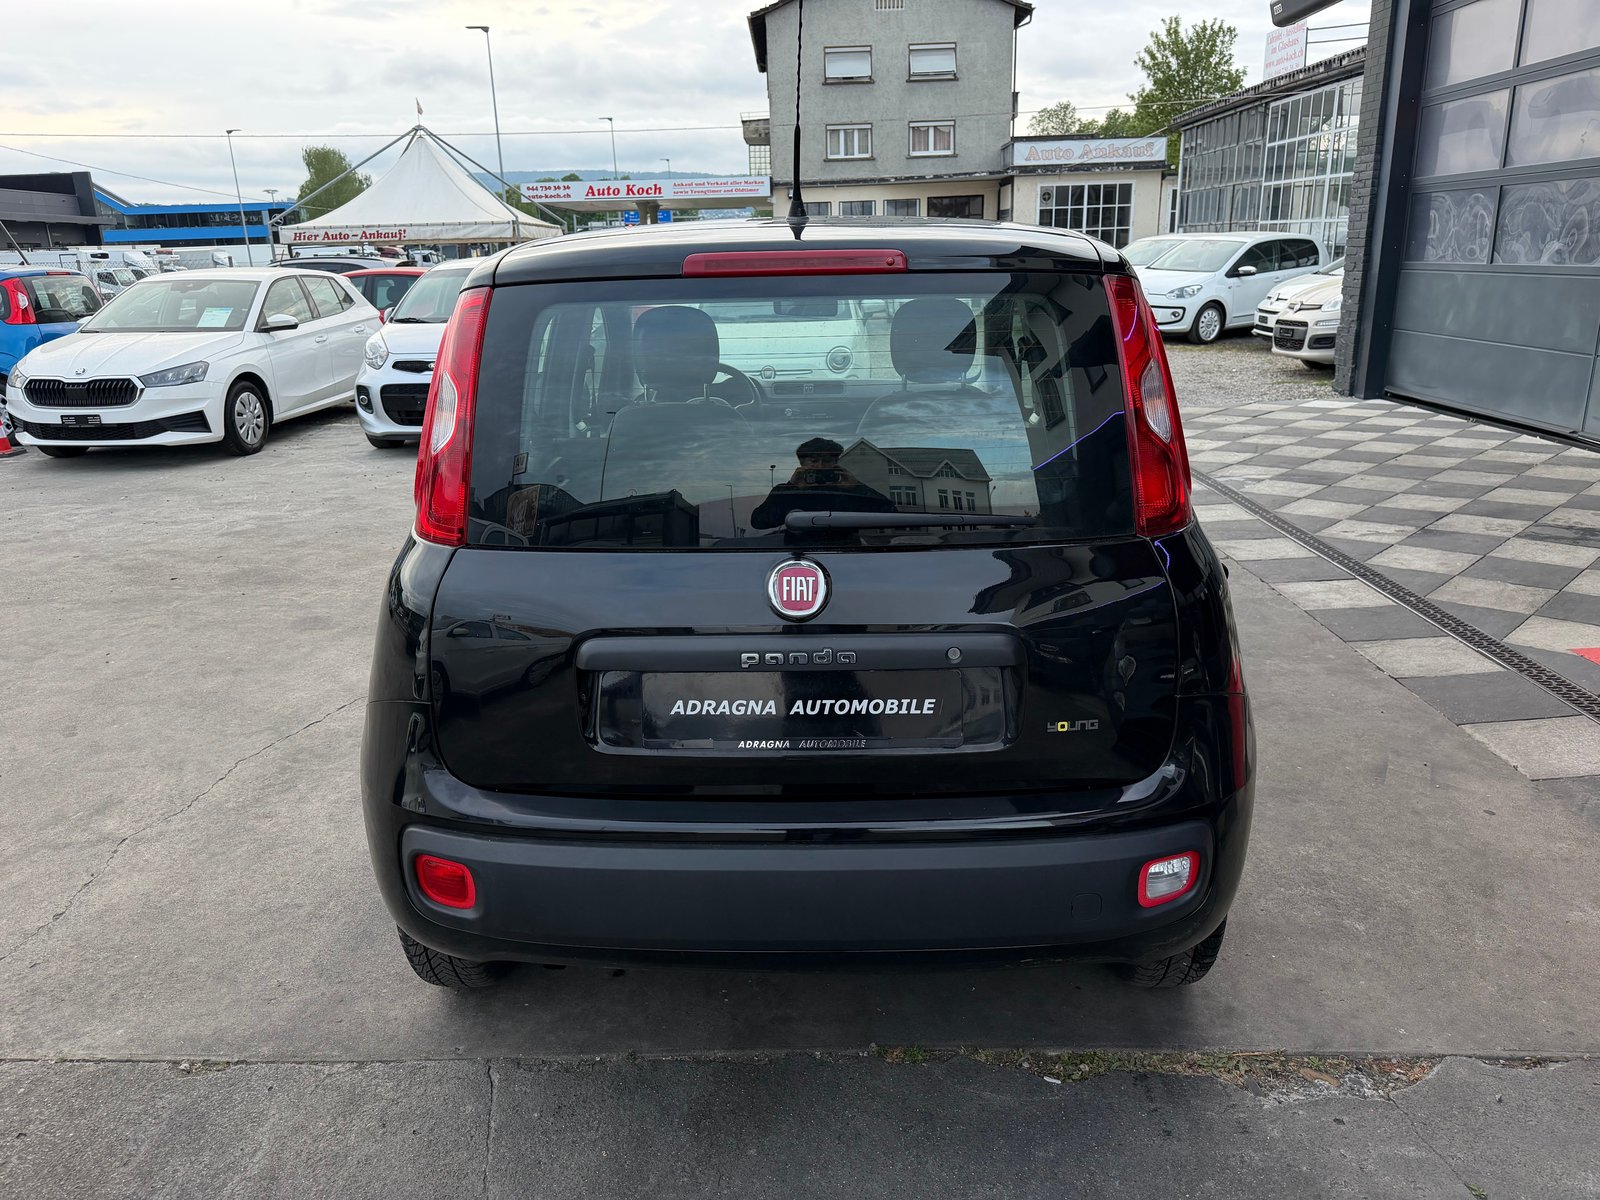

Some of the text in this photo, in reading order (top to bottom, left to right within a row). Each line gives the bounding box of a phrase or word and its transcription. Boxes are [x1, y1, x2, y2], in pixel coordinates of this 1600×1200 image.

[1024, 141, 1155, 161] Auto Ankauf
[585, 183, 663, 196] Auto Koch
[293, 231, 319, 241] Hier
[782, 576, 815, 601] FIAT
[740, 648, 857, 668] panda
[669, 698, 937, 715] ADRAGNA AUTOMOBILE
[737, 739, 867, 749] ADRAGNA AUTOMOBILE
